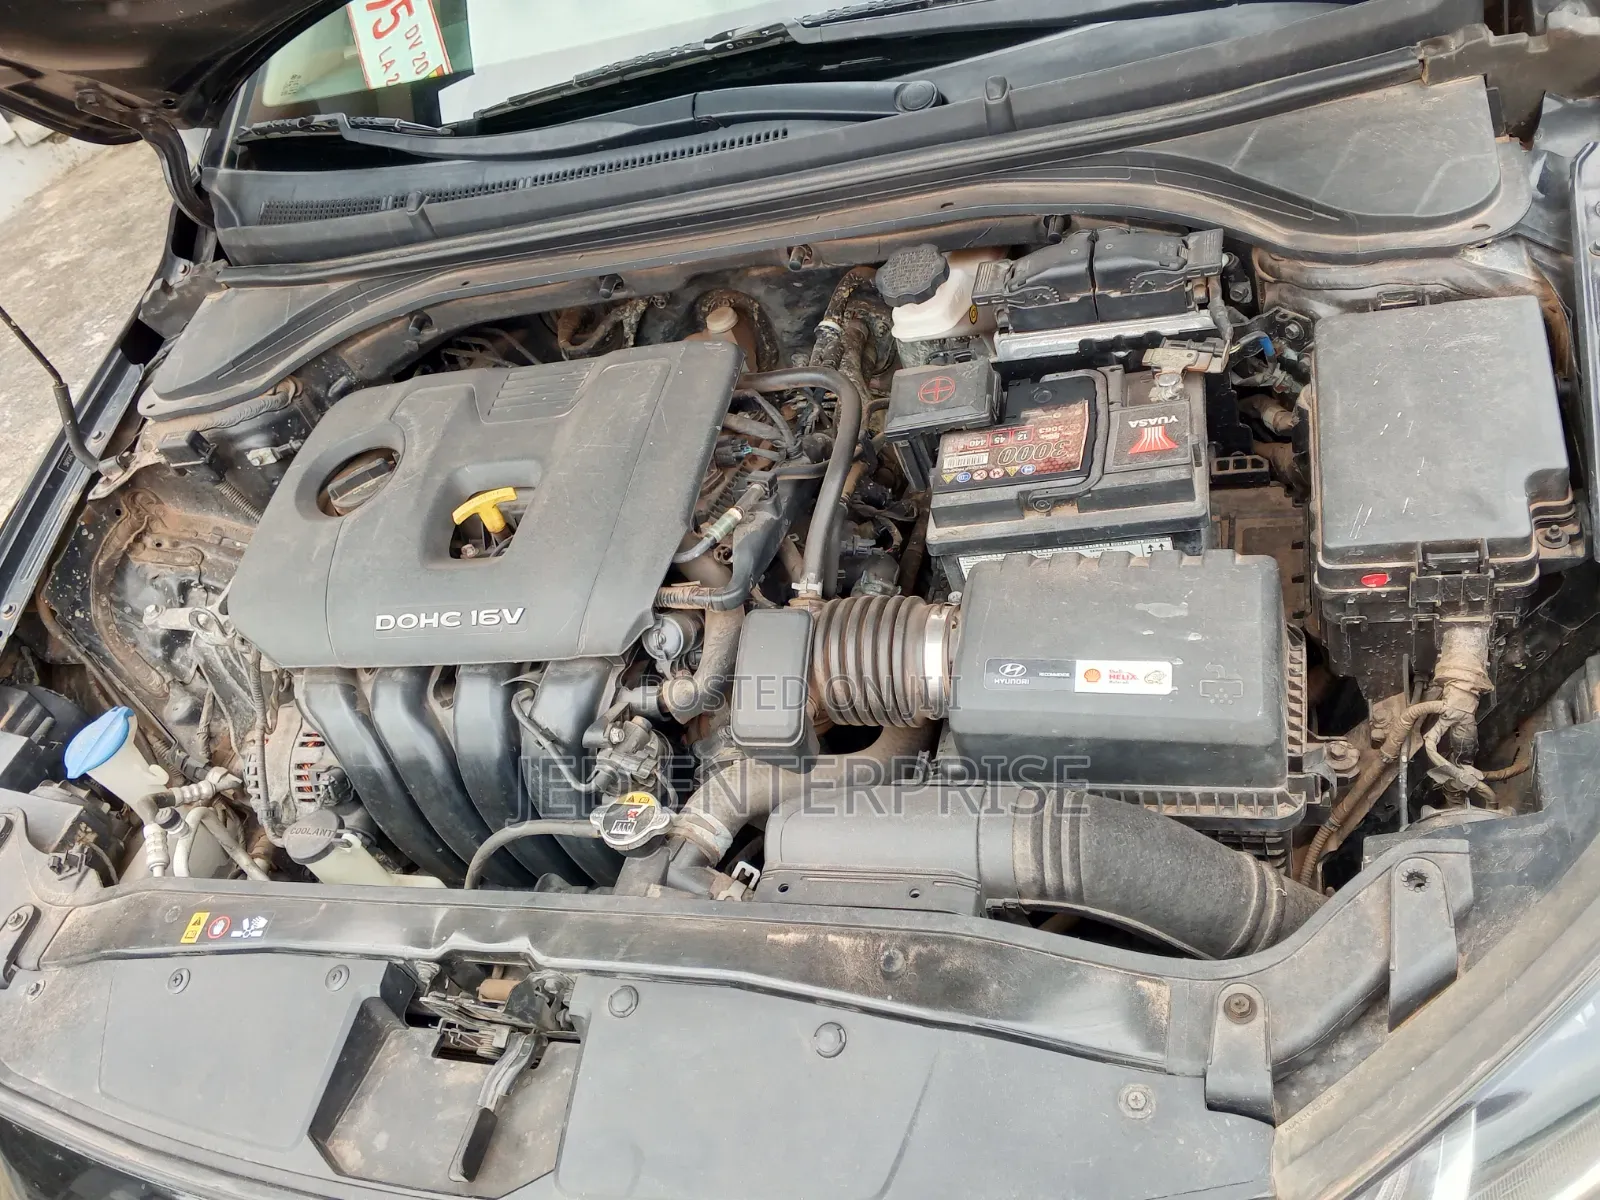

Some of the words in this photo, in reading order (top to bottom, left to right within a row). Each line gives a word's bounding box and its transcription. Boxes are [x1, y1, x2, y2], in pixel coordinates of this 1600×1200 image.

[404, 24, 423, 50] DV
[379, 46, 395, 74] LA
[412, 51, 429, 75] 20
[1128, 415, 1179, 428] YUASA
[969, 438, 987, 447] 440
[994, 436, 1006, 445] 45
[1017, 432, 1028, 441] 12
[997, 440, 1071, 466] 3000
[375, 611, 462, 631] DOHC
[470, 607, 525, 627] 16V
[994, 678, 1030, 686] HYUNDAI
[1109, 673, 1138, 681] HELIX
[290, 827, 336, 838] COOLANT
